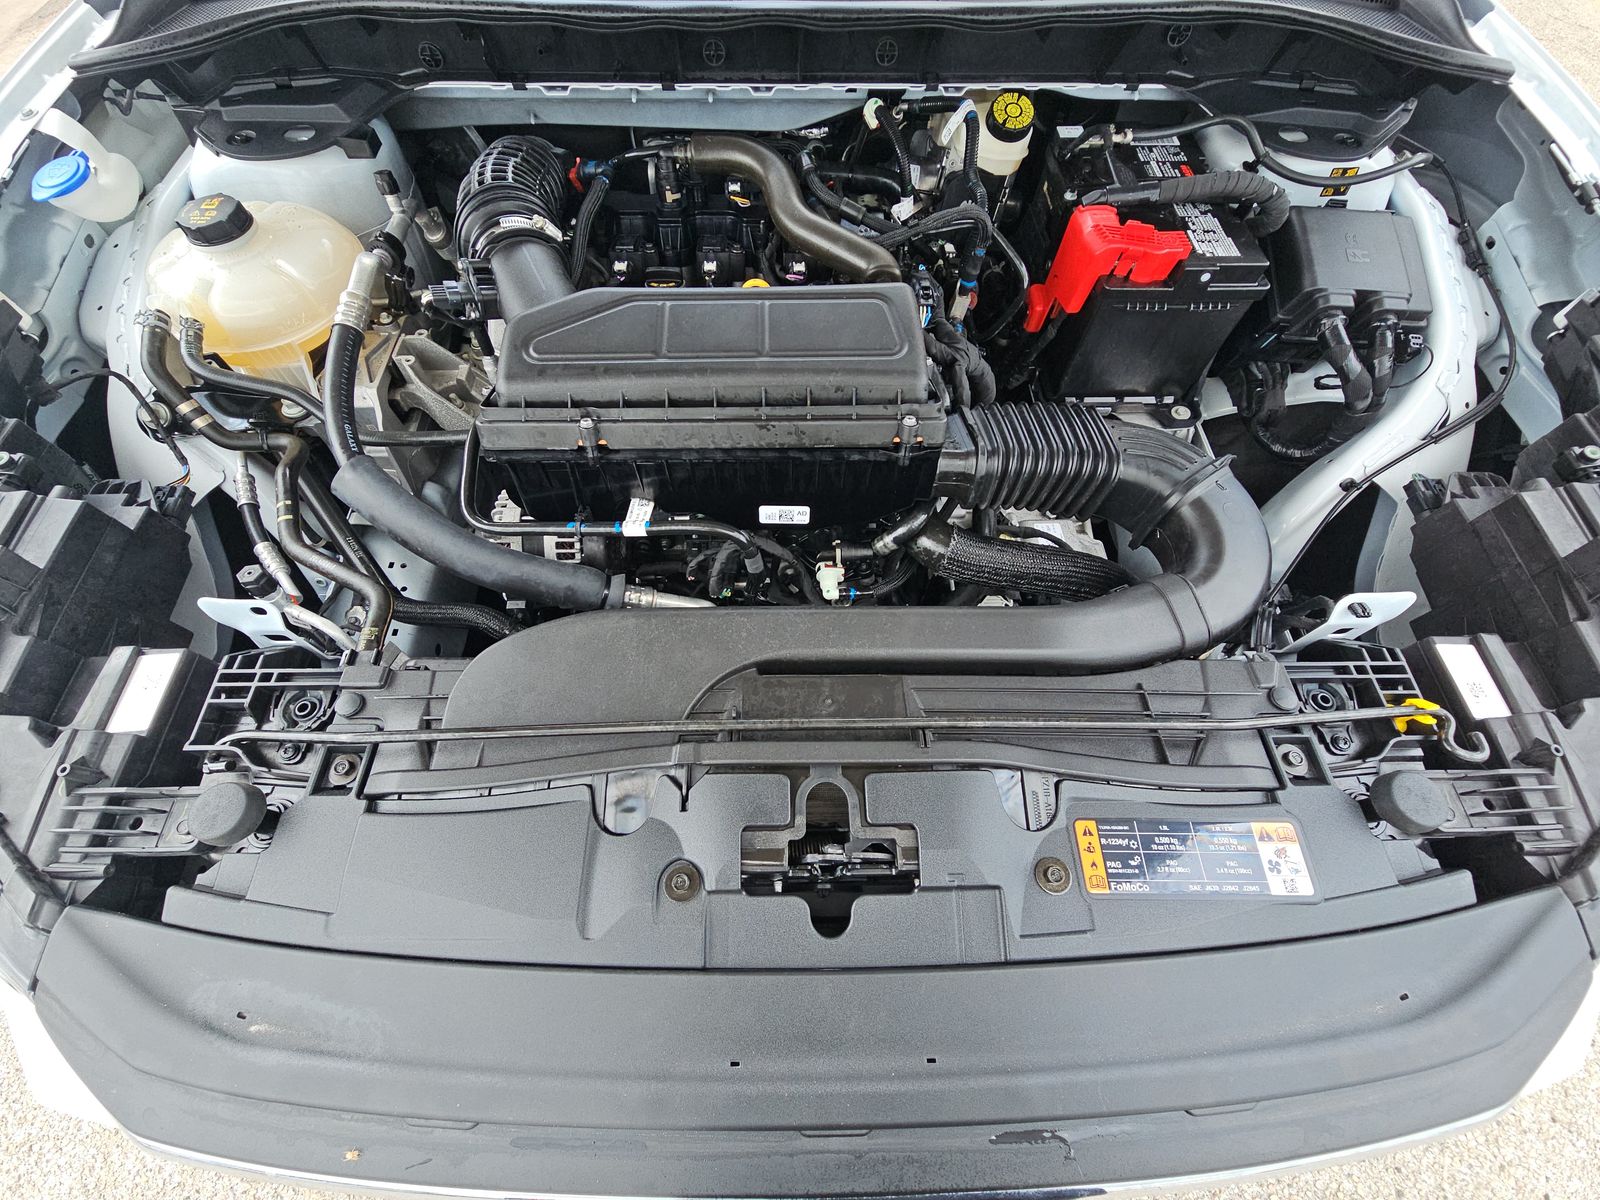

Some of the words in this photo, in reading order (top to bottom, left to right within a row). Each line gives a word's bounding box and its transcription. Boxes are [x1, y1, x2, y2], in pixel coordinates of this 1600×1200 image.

[344, 423, 359, 453] GALAXY
[1100, 837, 1129, 847] R-1234yf
[1110, 882, 1150, 891] FoMoCo
